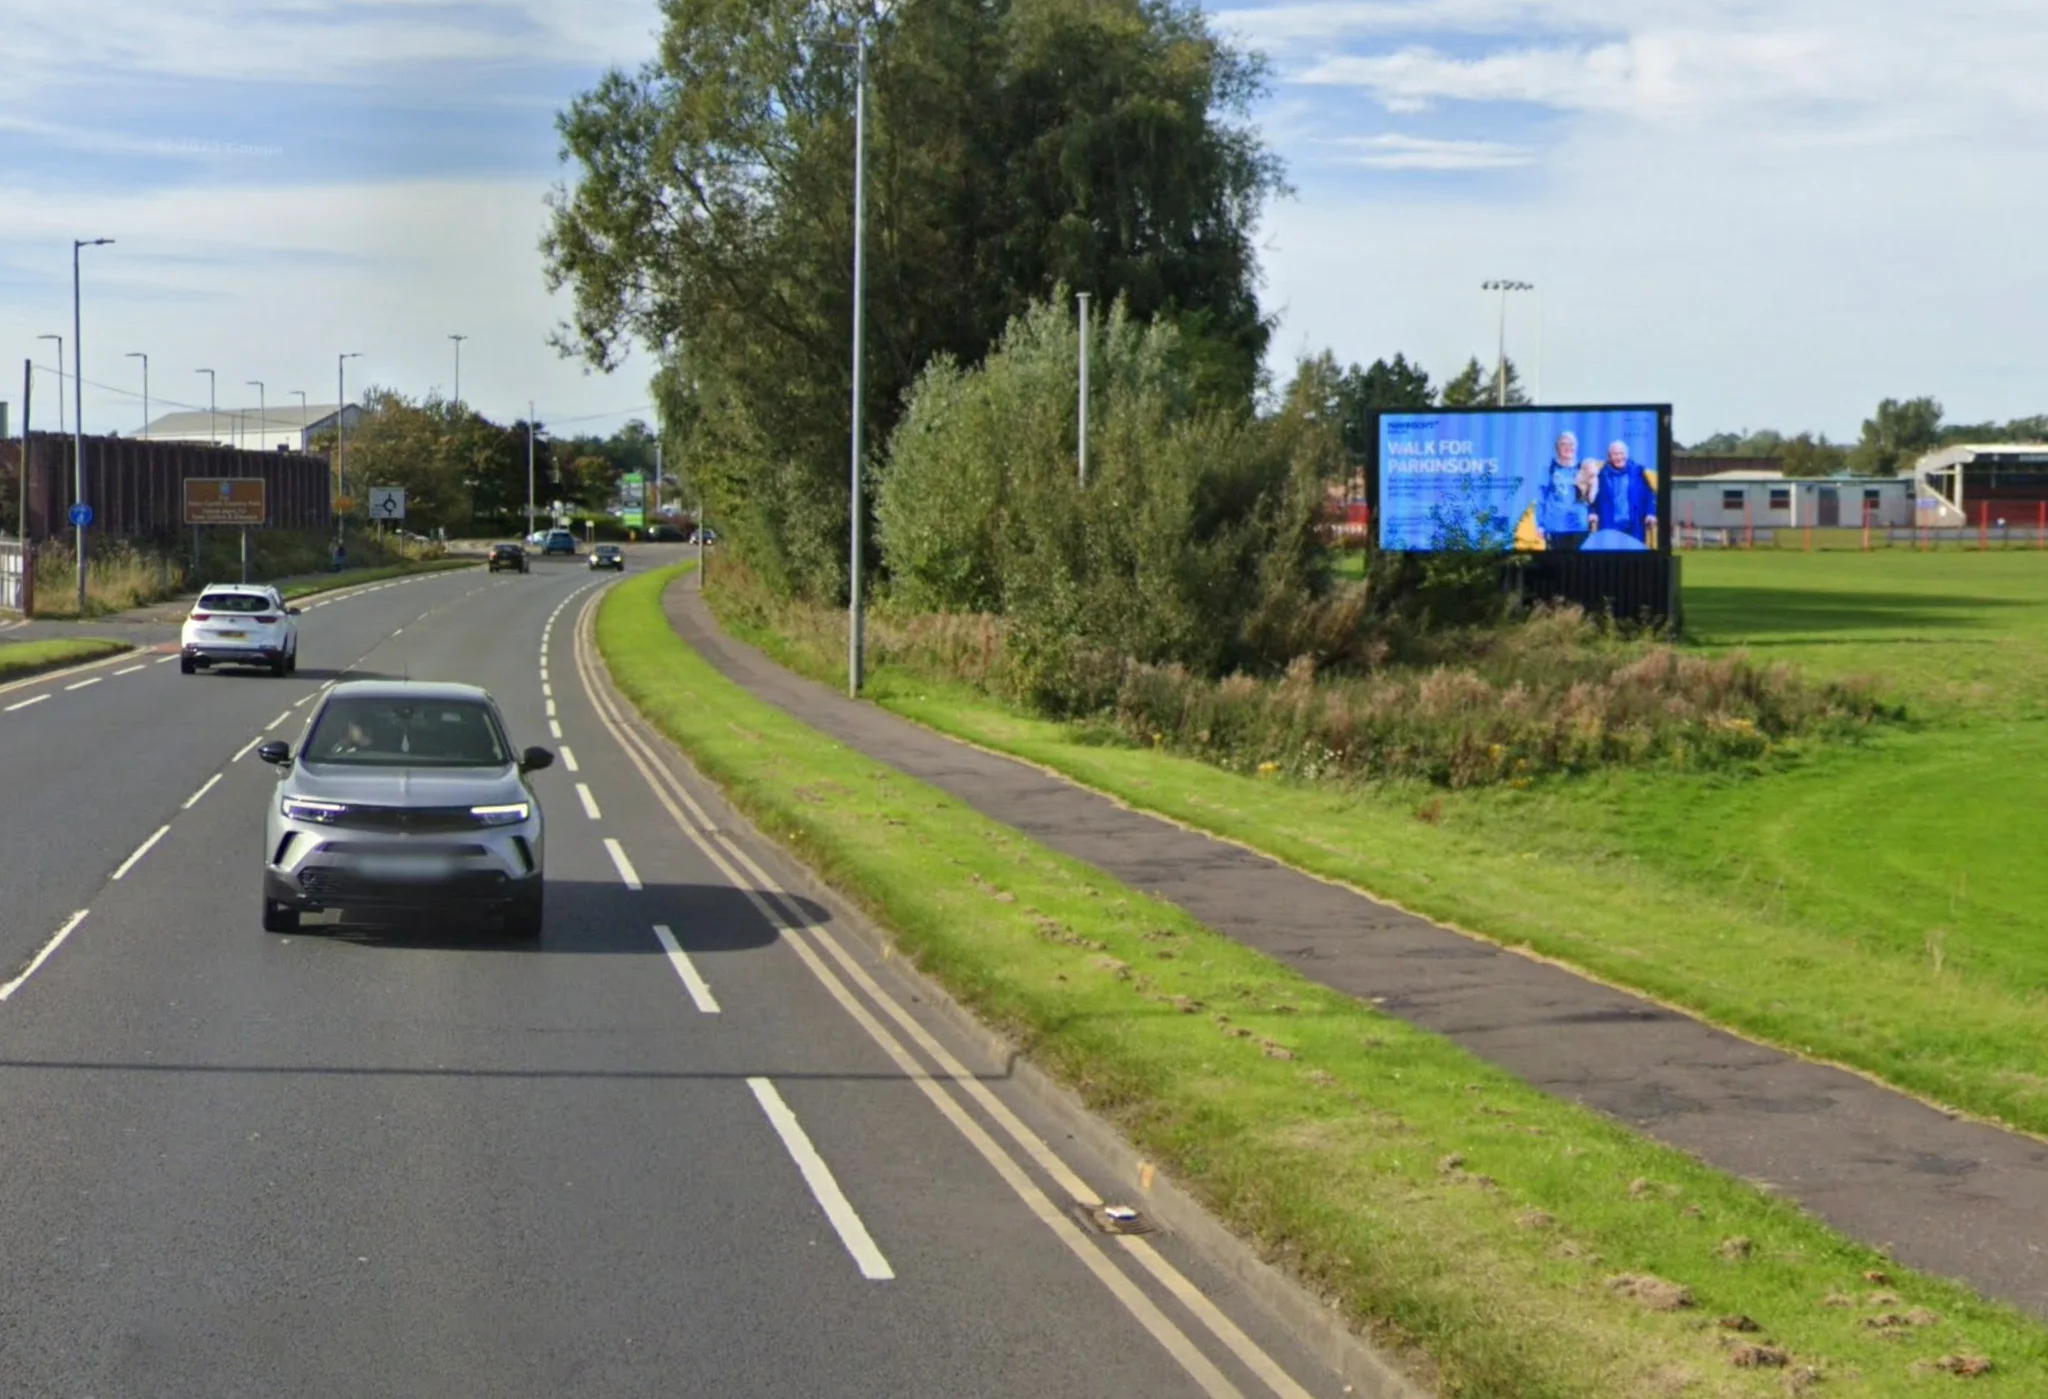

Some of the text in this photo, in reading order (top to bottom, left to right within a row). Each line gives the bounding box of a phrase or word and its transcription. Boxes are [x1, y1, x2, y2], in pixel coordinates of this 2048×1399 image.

[1387, 440, 1473, 455] WALK FOR
[1387, 458, 1499, 474] PARKINSON'S
